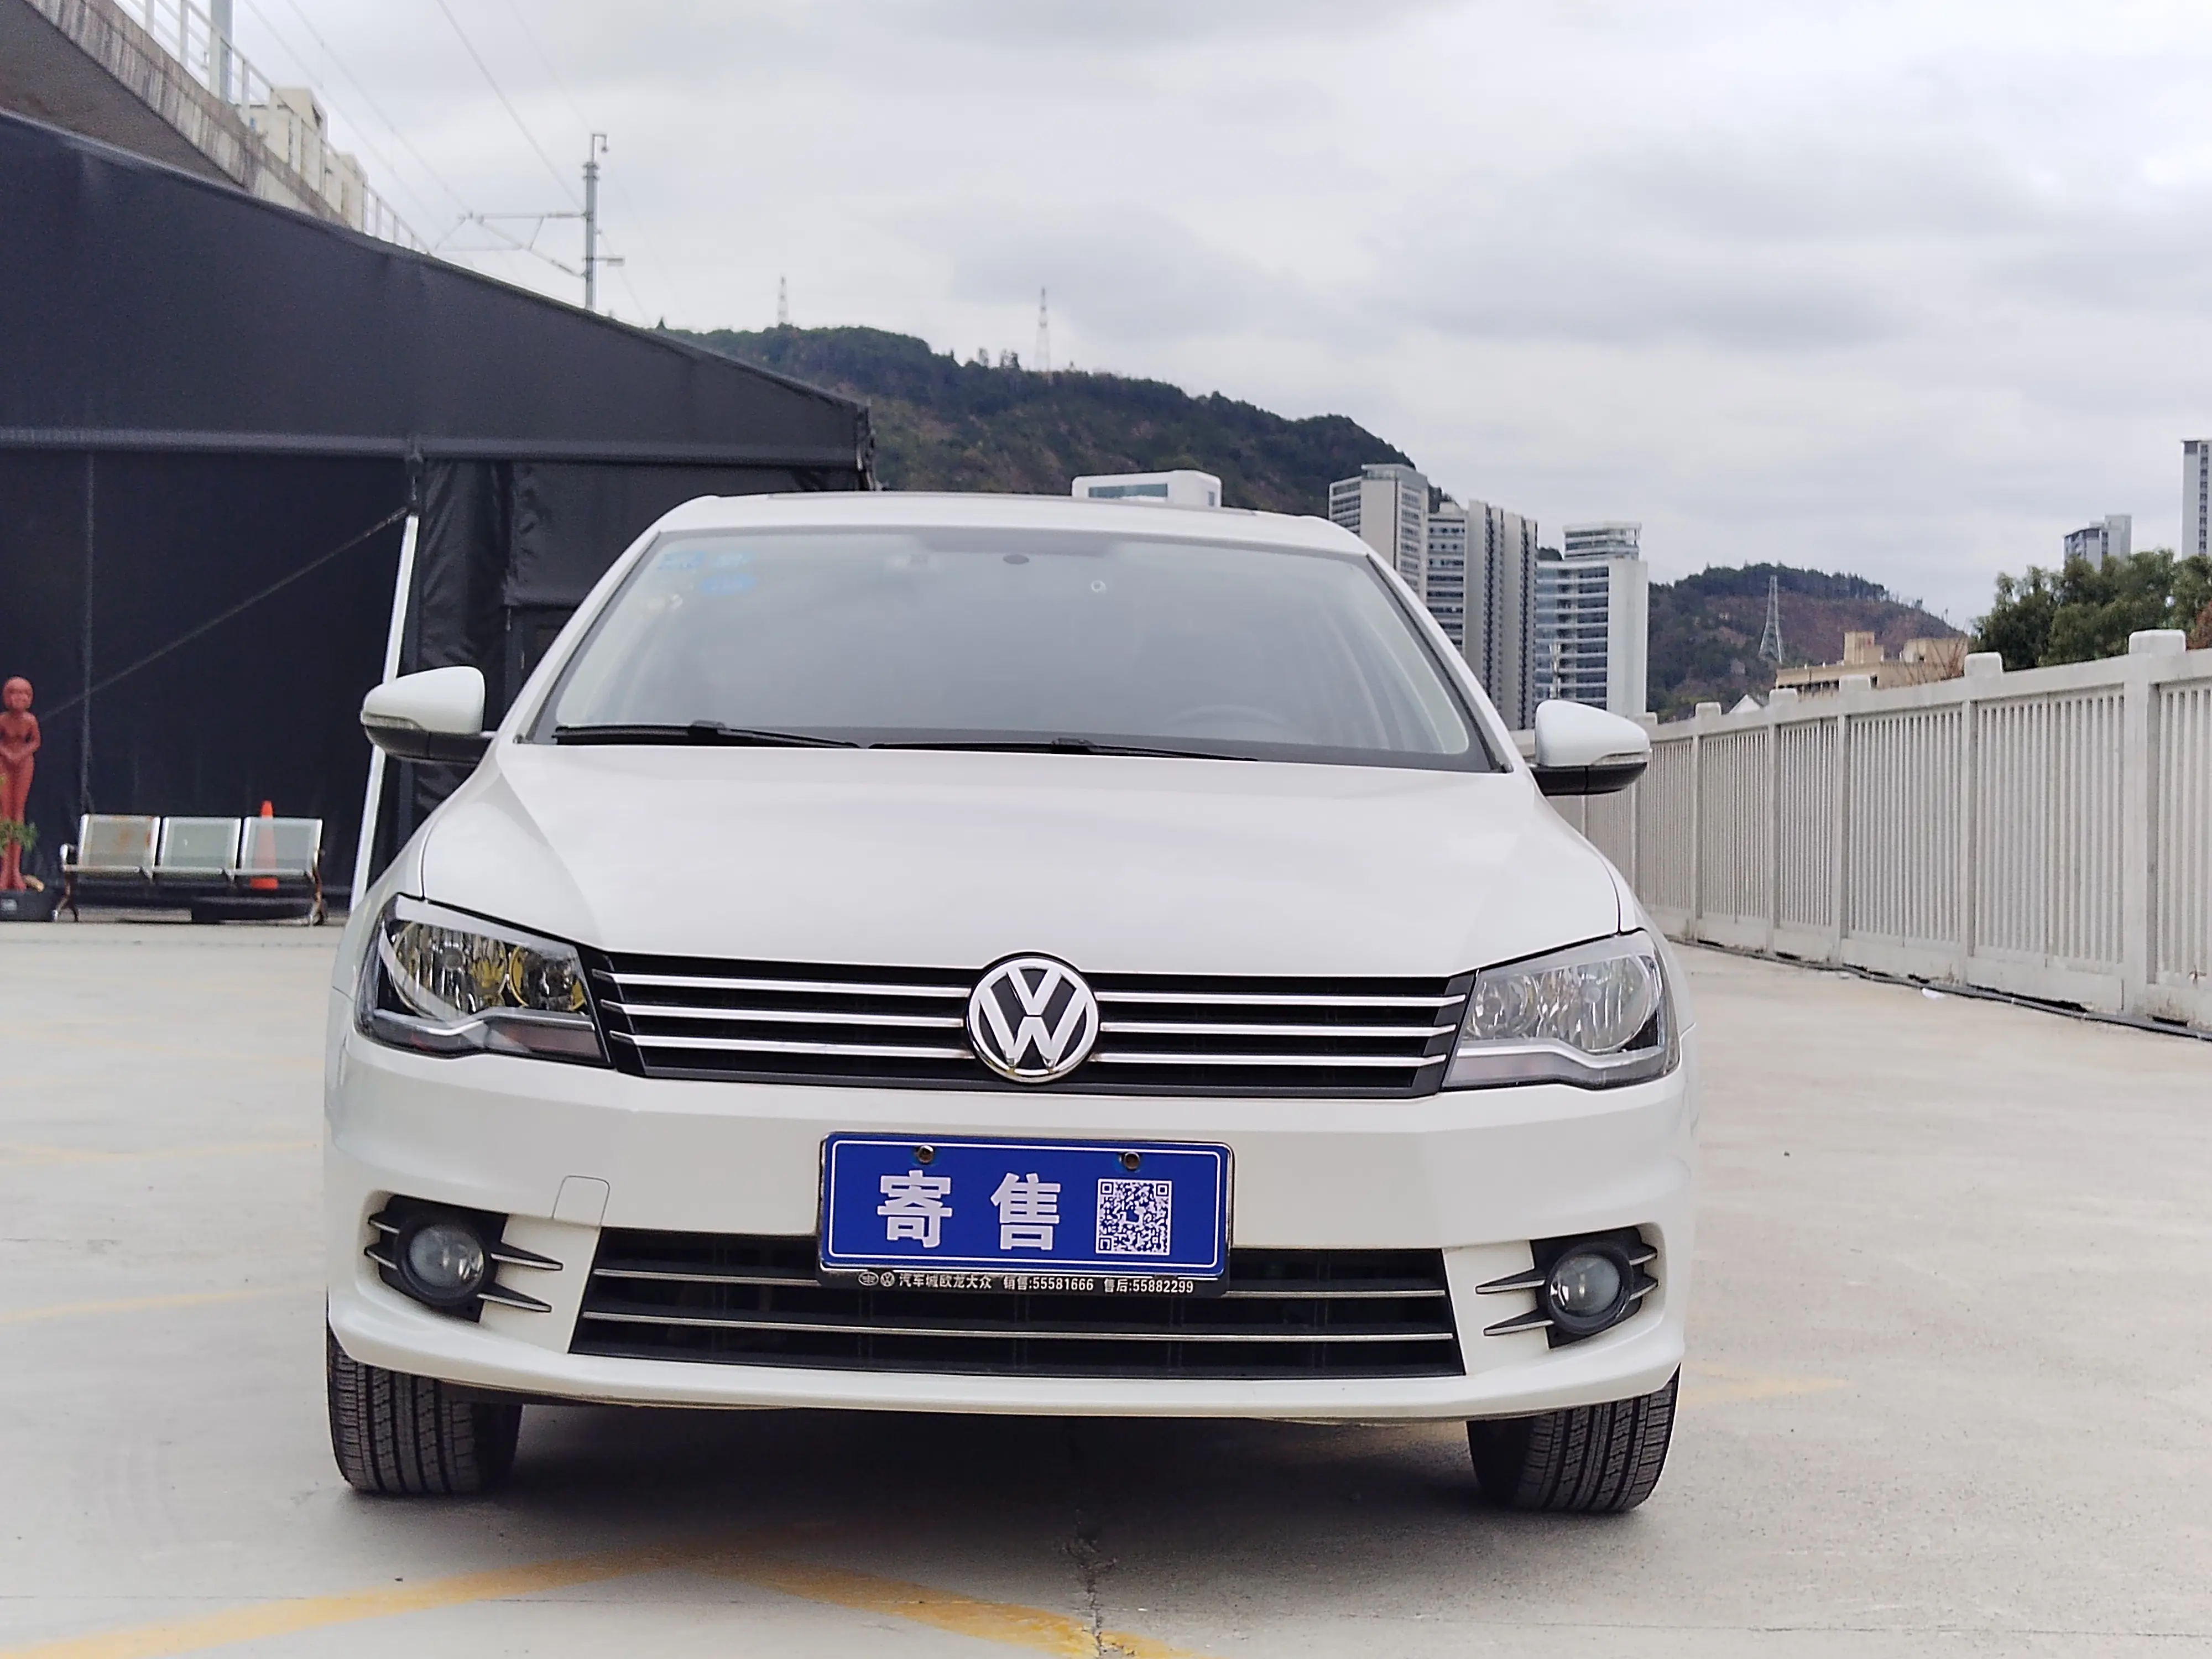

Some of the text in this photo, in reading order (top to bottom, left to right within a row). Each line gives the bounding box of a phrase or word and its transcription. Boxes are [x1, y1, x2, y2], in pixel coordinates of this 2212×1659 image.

[877, 1170, 1061, 1250] 寄售
[899, 1273, 992, 1288] 汽车城欧龙大众
